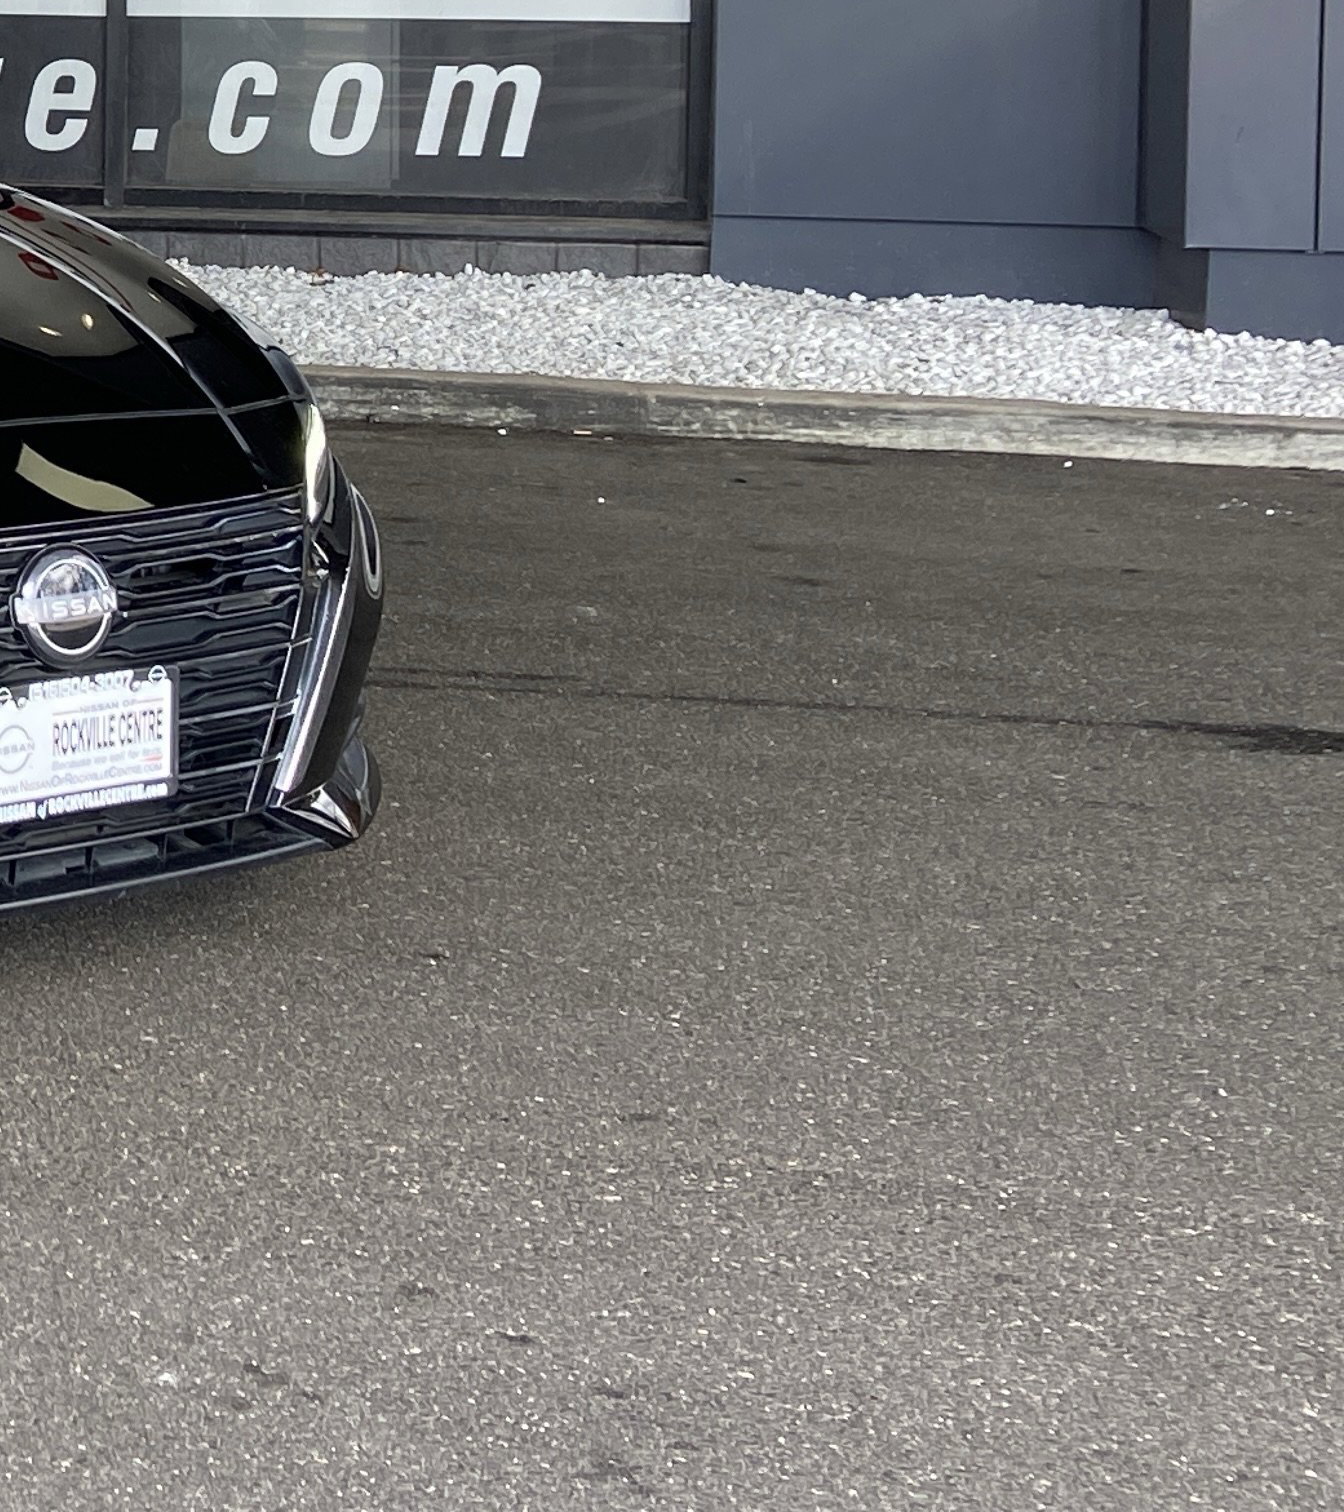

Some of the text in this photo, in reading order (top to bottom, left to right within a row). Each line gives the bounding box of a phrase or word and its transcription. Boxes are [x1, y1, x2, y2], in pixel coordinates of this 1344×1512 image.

[15, 590, 118, 624] NISSAN
[79, 700, 119, 713] NISSAN
[52, 709, 163, 757] ROCKVILLE CENTRE
